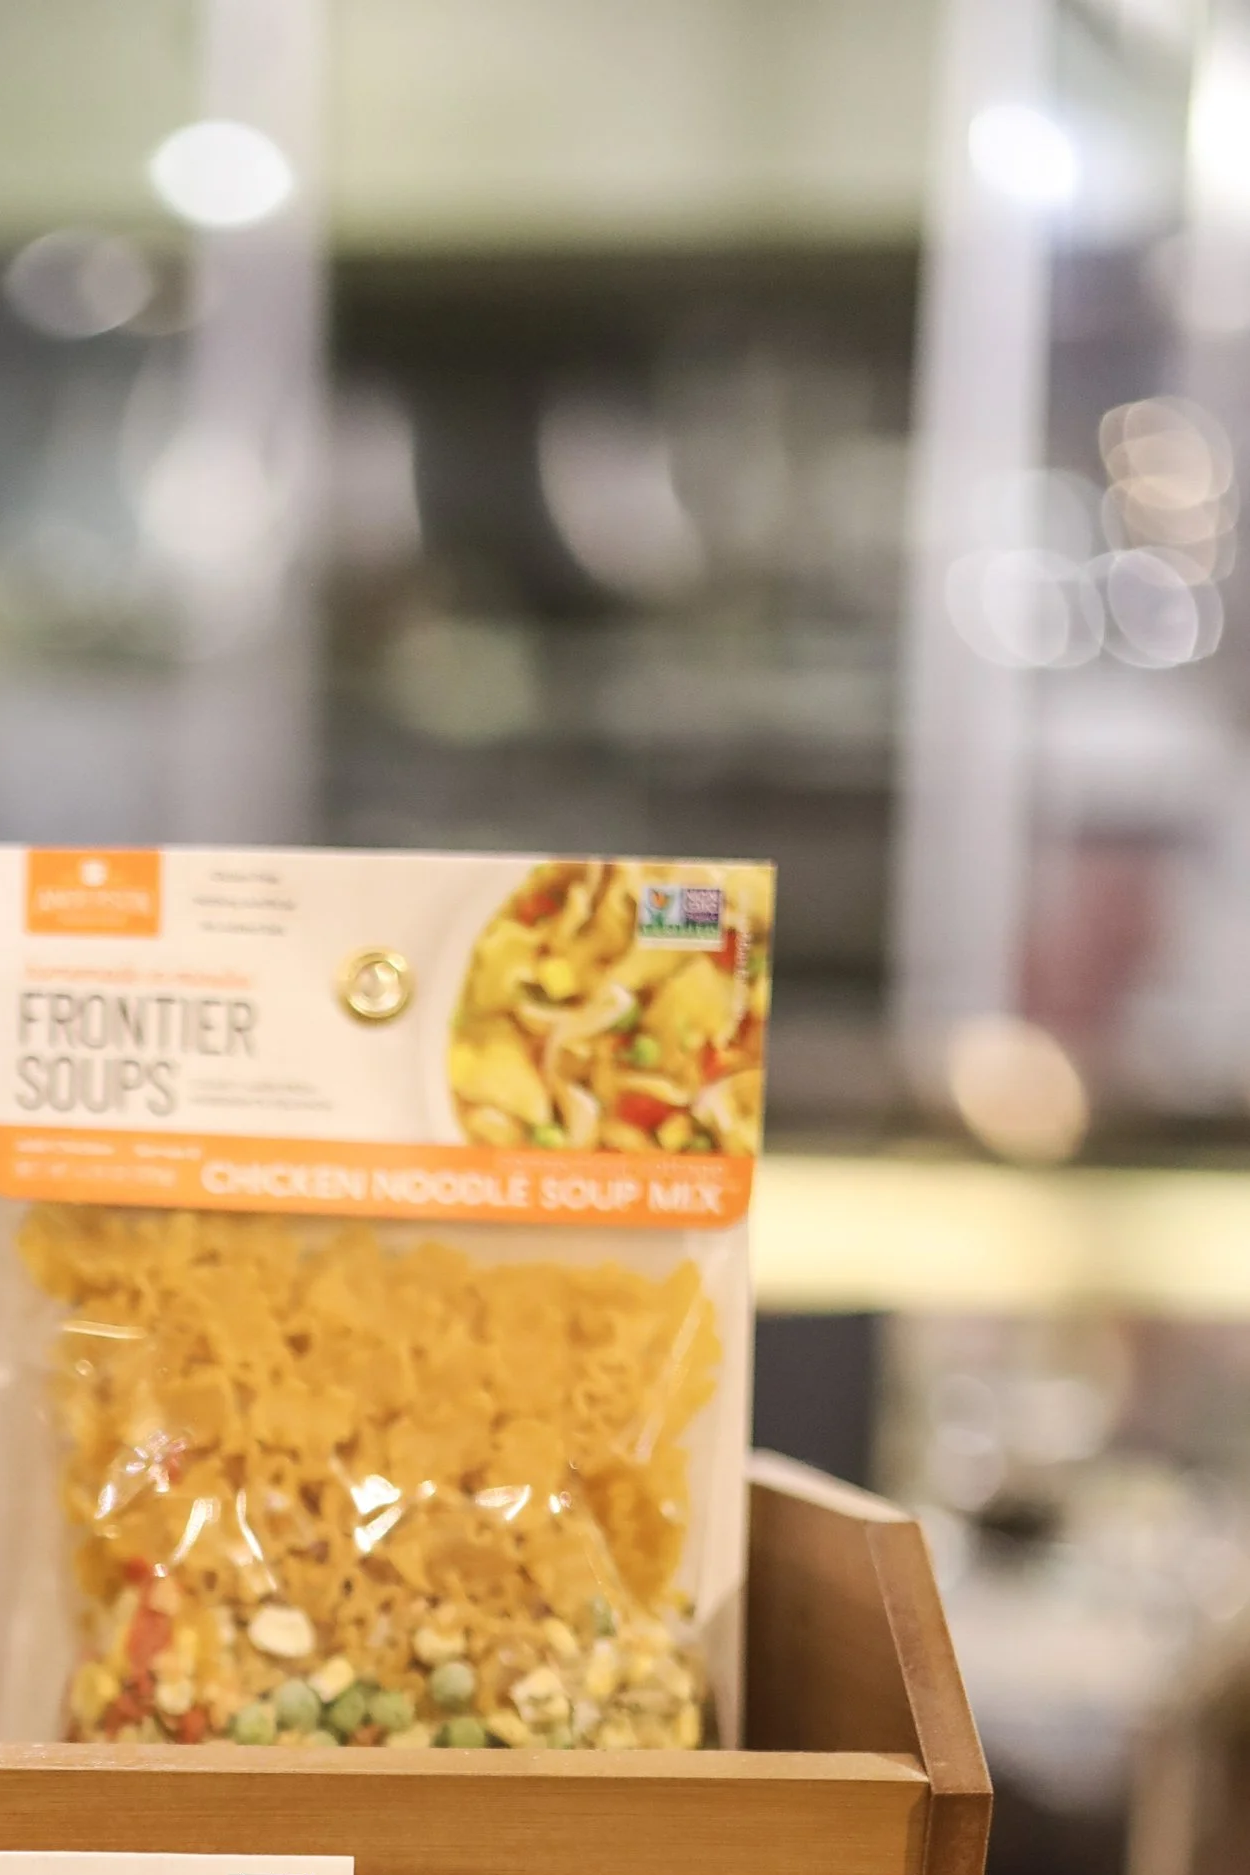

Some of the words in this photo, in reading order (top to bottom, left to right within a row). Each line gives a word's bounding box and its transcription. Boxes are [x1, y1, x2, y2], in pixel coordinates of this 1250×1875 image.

[19, 993, 257, 1057] FRONTIER
[15, 1055, 177, 1117] SOUPS
[201, 1160, 369, 1200] CHICKEN
[371, 1165, 530, 1208] NOODLE
[539, 1175, 643, 1212] SOUP
